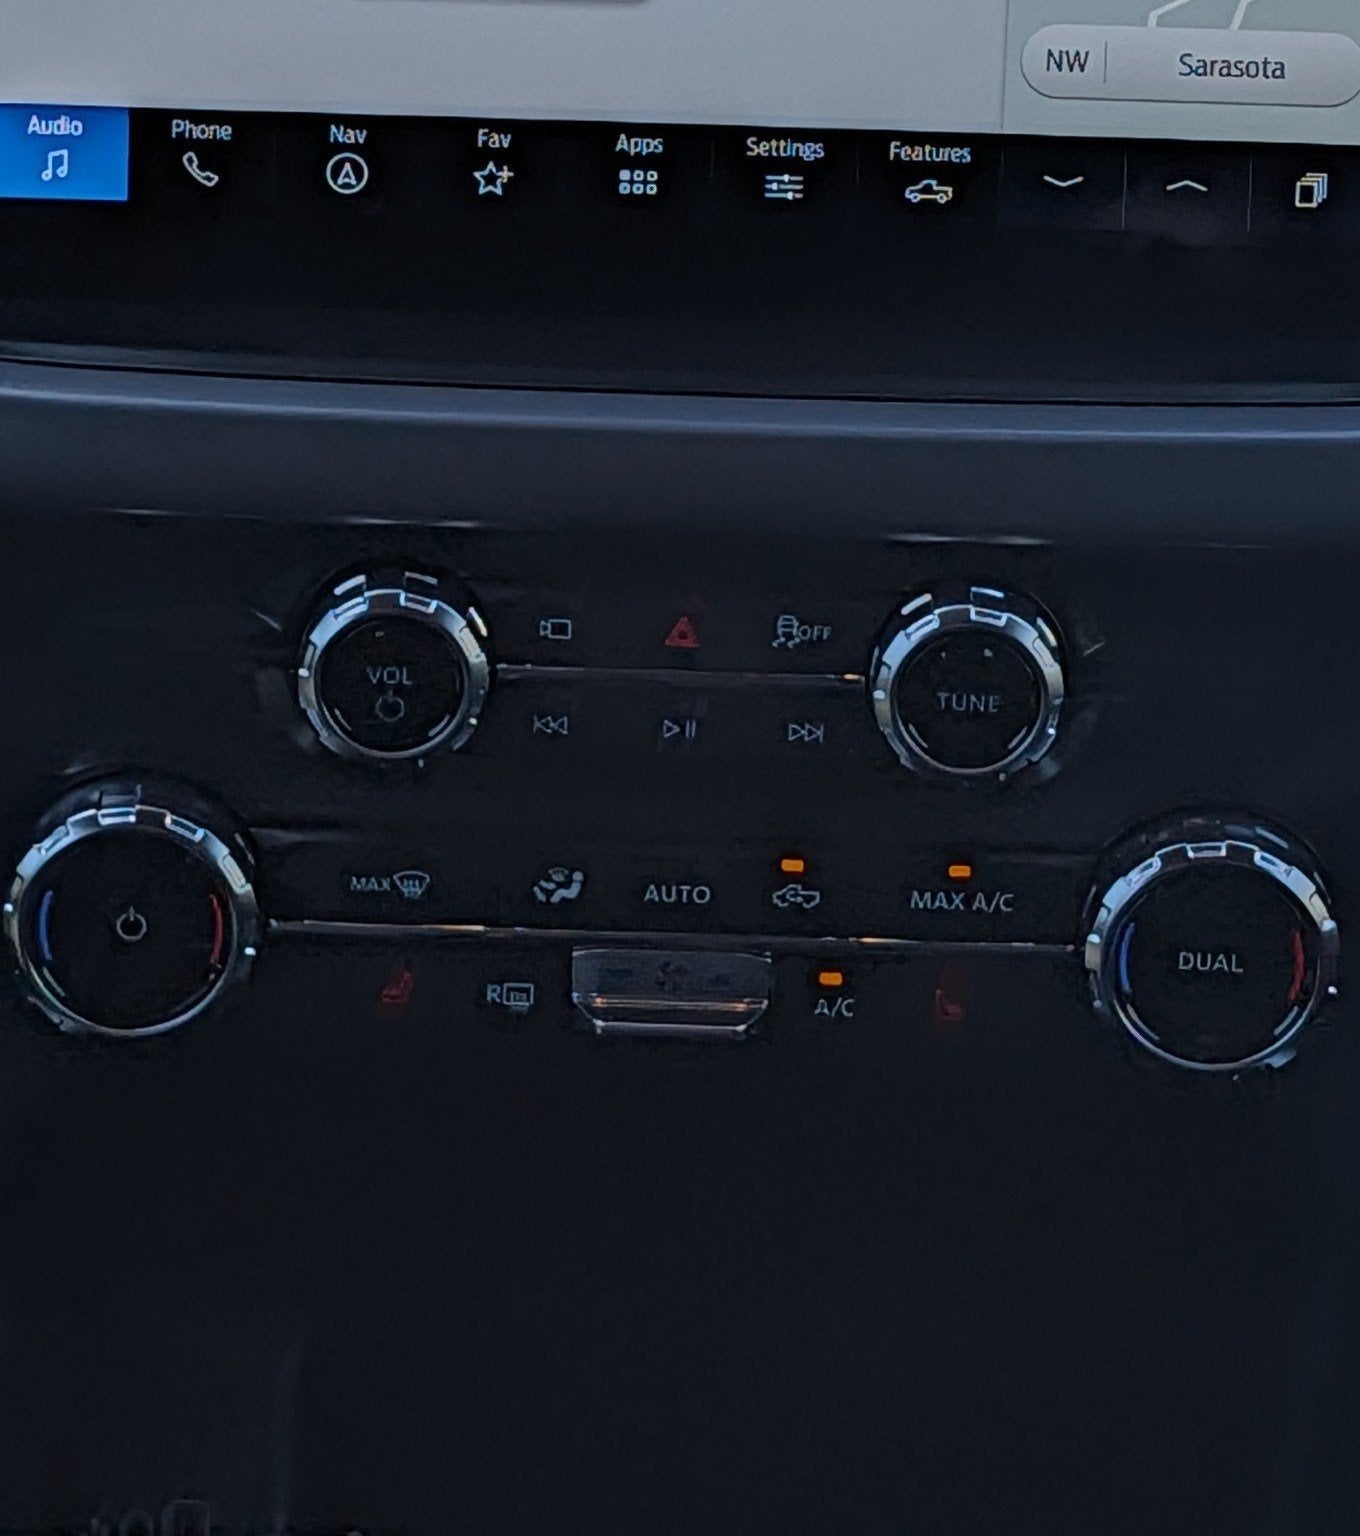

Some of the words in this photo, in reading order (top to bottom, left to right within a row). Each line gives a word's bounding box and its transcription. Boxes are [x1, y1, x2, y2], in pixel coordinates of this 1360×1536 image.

[1045, 48, 1090, 74] NW
[1177, 52, 1287, 80] Sarasota
[27, 114, 84, 138] Audio
[171, 118, 233, 142] Phone
[329, 123, 368, 146] Nav
[477, 128, 513, 150] Fav
[615, 133, 664, 157] Apps
[745, 136, 826, 162] Settings
[889, 141, 972, 164] Features
[799, 623, 833, 641] OFF
[365, 666, 414, 687] VOL
[936, 691, 1002, 713] TUNE
[349, 874, 391, 893] MAX
[643, 883, 712, 905] AUTO
[910, 889, 966, 911] MAX
[971, 889, 1015, 914] A/C
[1178, 950, 1245, 973] DUAL
[485, 982, 500, 1004] R
[813, 997, 855, 1019] A/C
